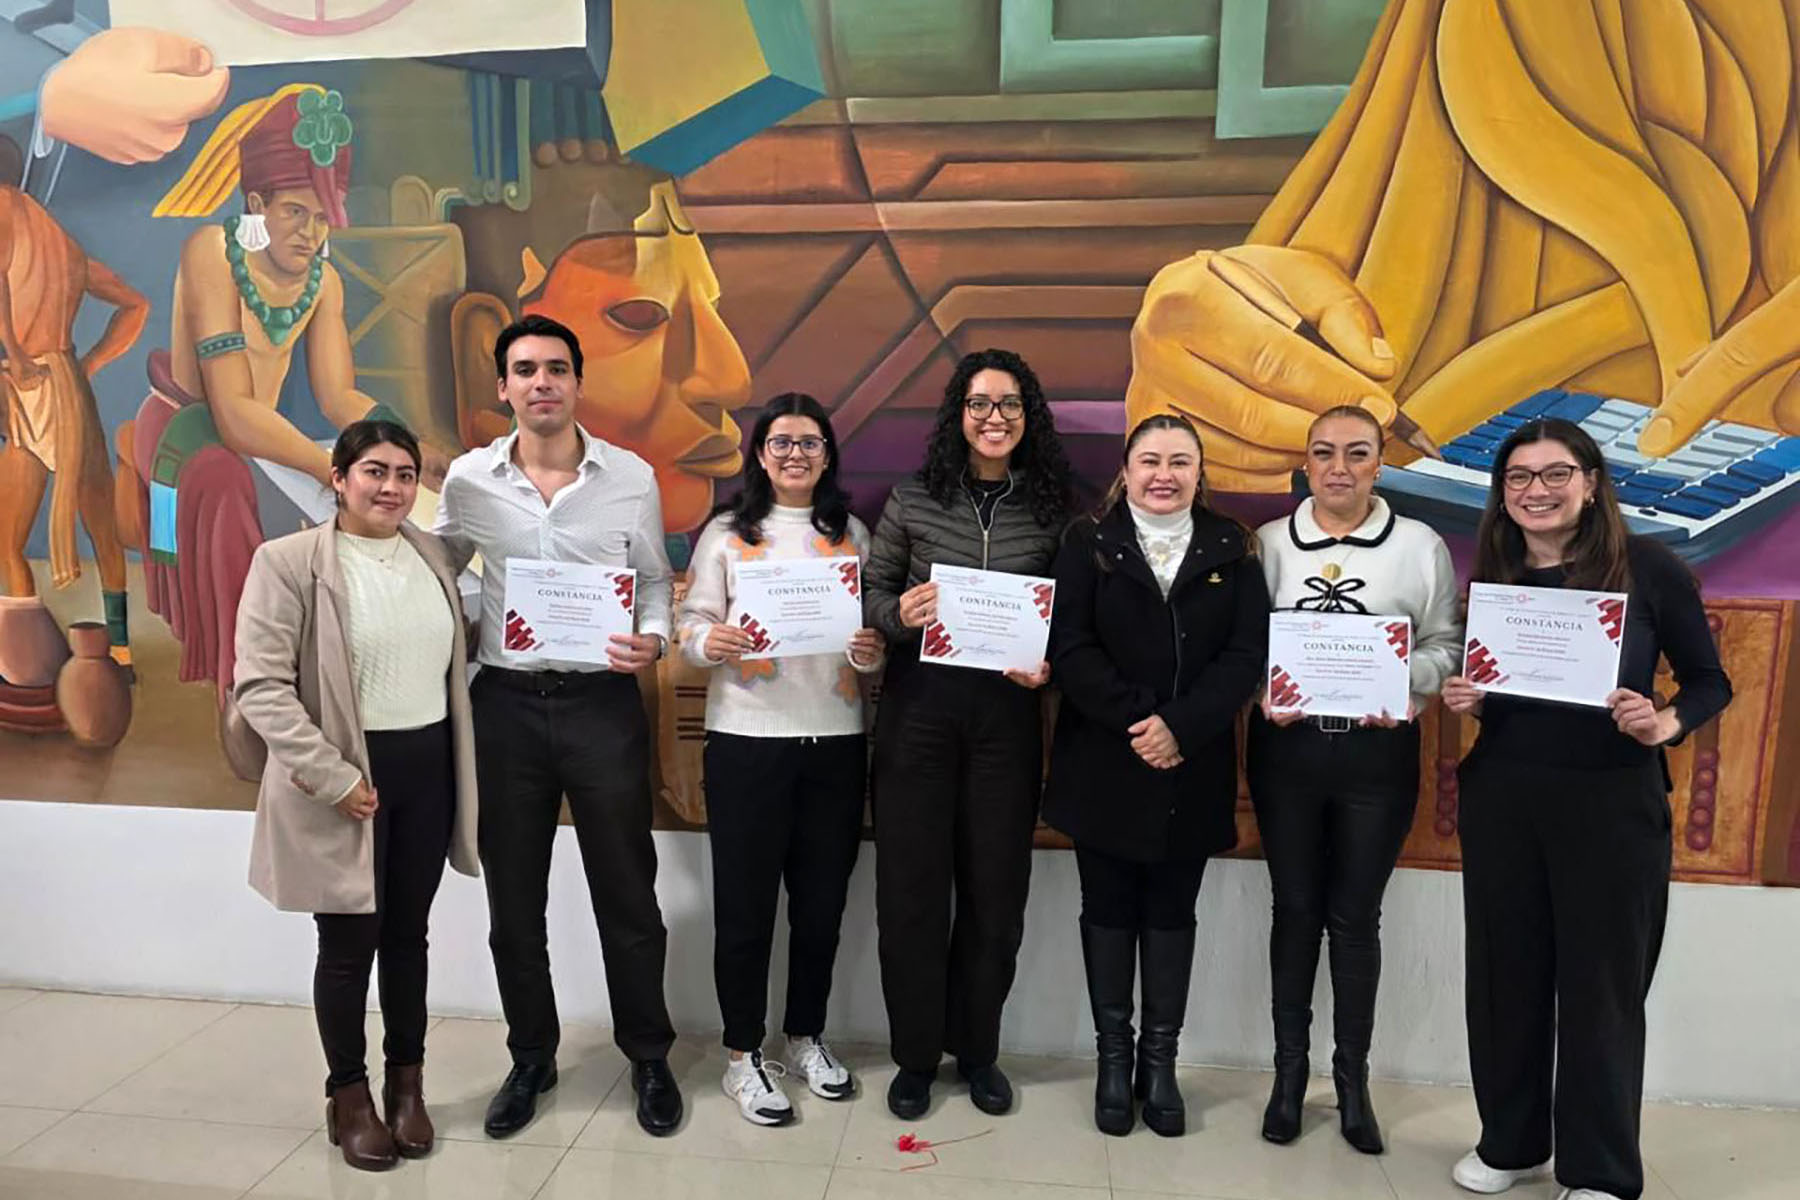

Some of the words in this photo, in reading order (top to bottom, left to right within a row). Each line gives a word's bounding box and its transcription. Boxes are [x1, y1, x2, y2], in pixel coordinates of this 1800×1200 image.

[538, 589, 603, 601] CONSTANCIA
[768, 585, 831, 596] CONSTANCIA
[959, 596, 1022, 610] CONSTANCIA
[1505, 616, 1584, 631] CONSTANCIA
[1303, 642, 1374, 653] CONSTANCIA
